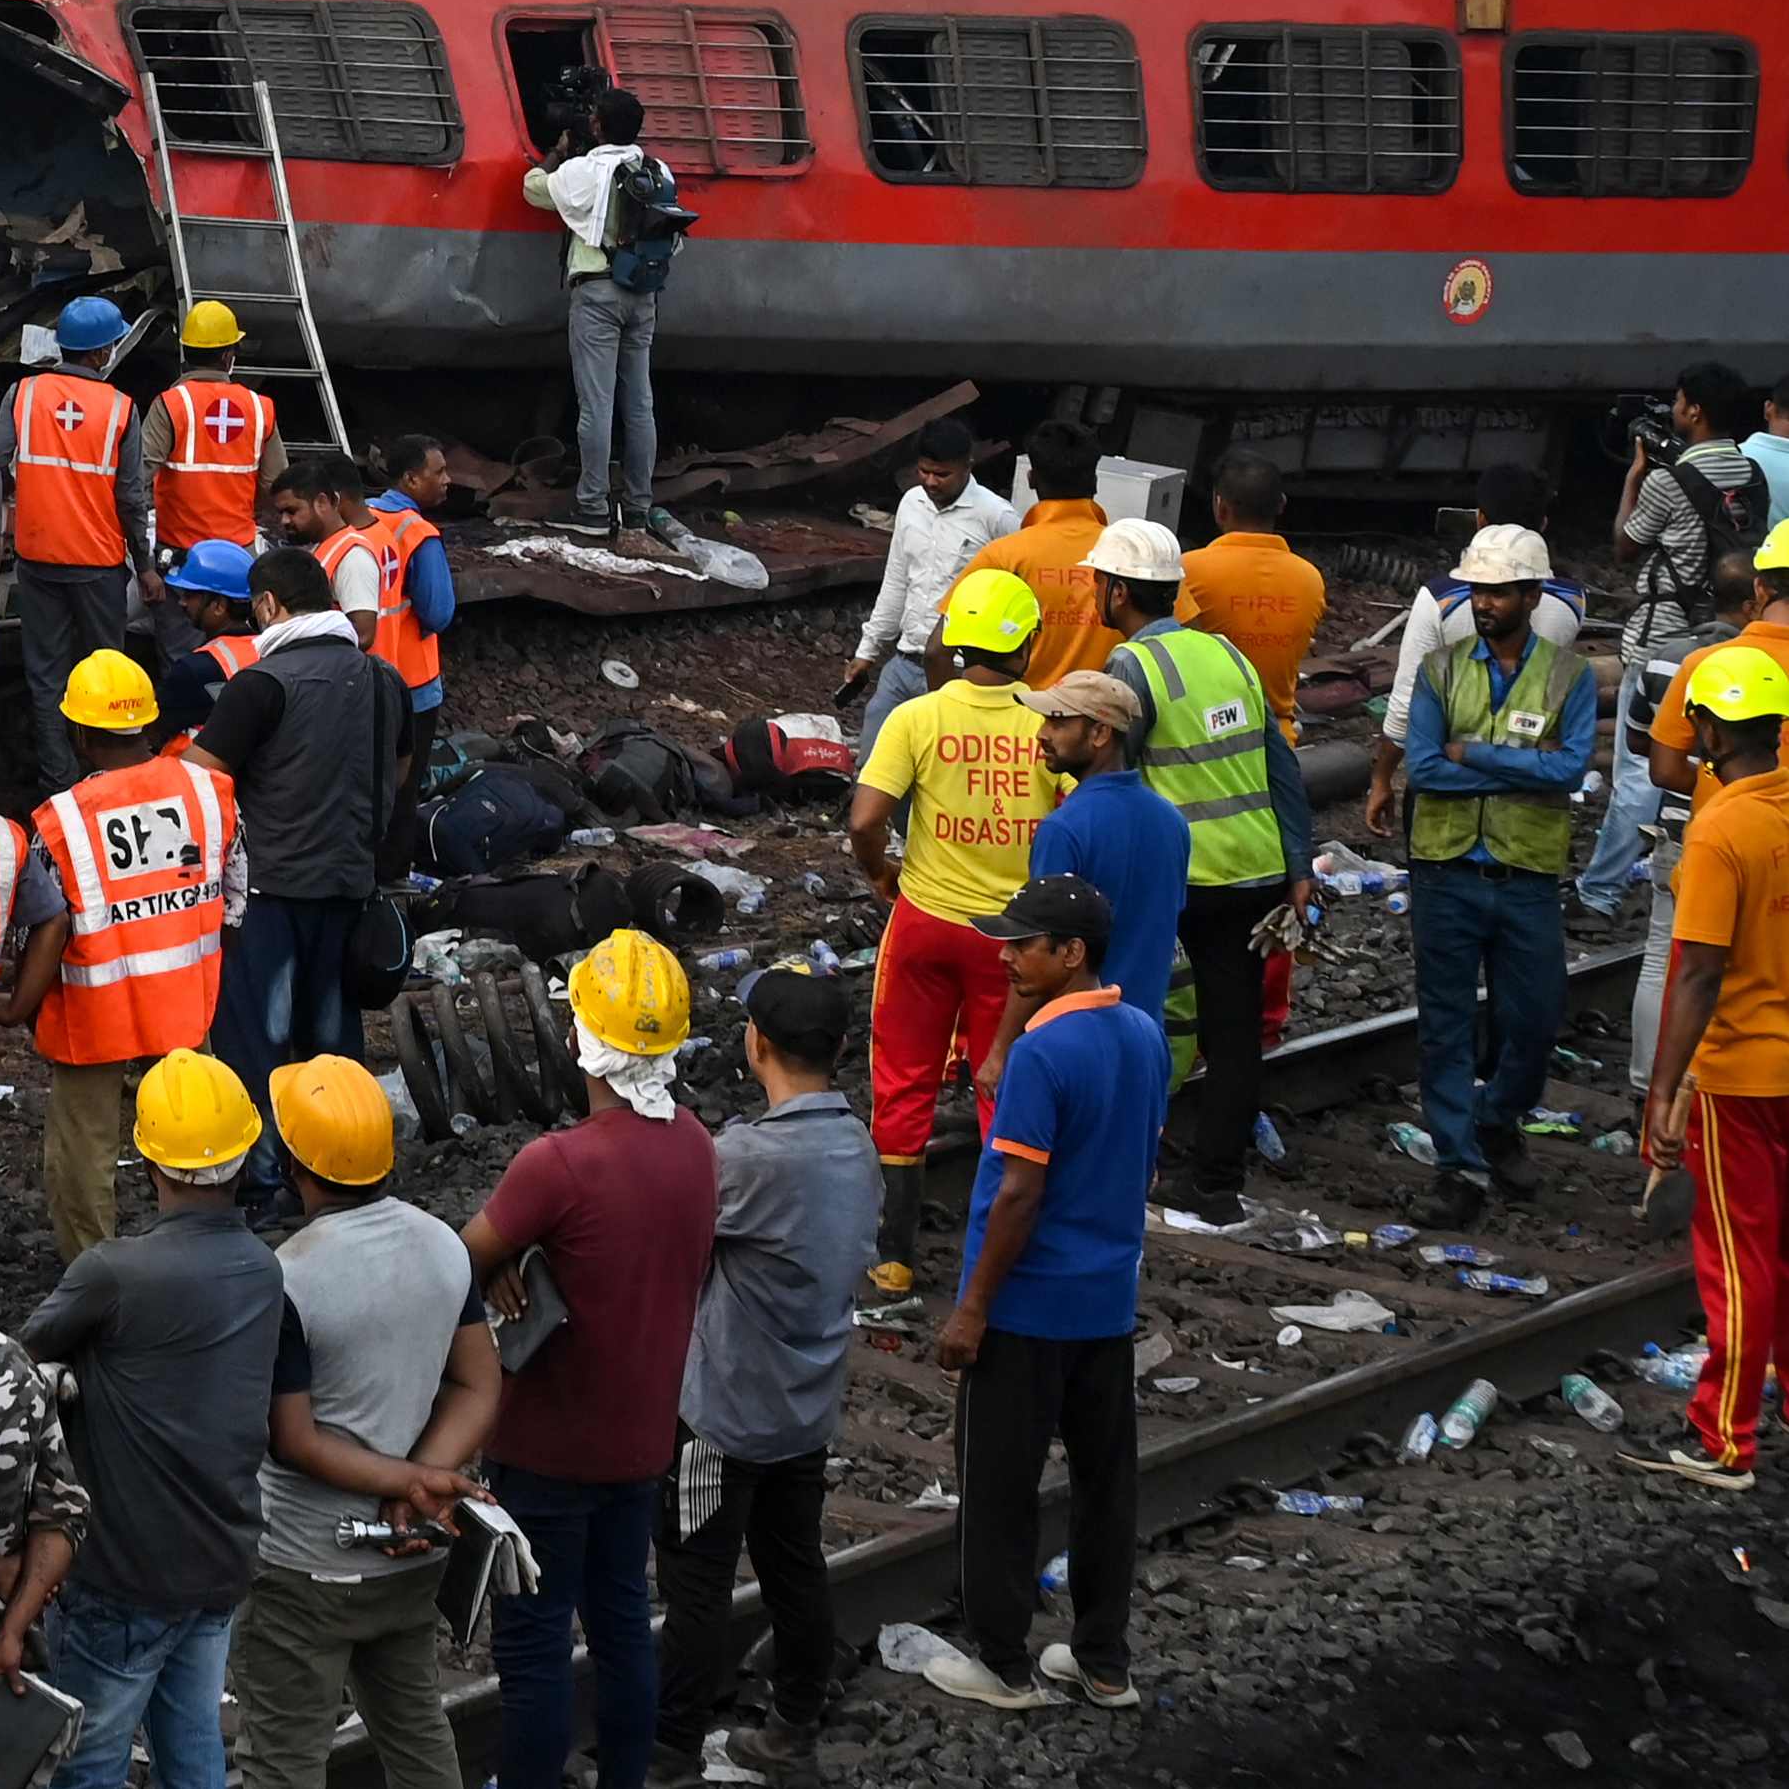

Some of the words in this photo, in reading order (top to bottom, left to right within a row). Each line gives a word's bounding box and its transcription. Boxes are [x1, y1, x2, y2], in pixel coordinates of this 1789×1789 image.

[1037, 566, 1090, 586] FIR
[1230, 594, 1295, 613] FIRE
[1209, 704, 1240, 730] PEW
[1514, 716, 1539, 730] PEW
[967, 769, 1031, 798] FIRE
[991, 797, 1005, 816] &
